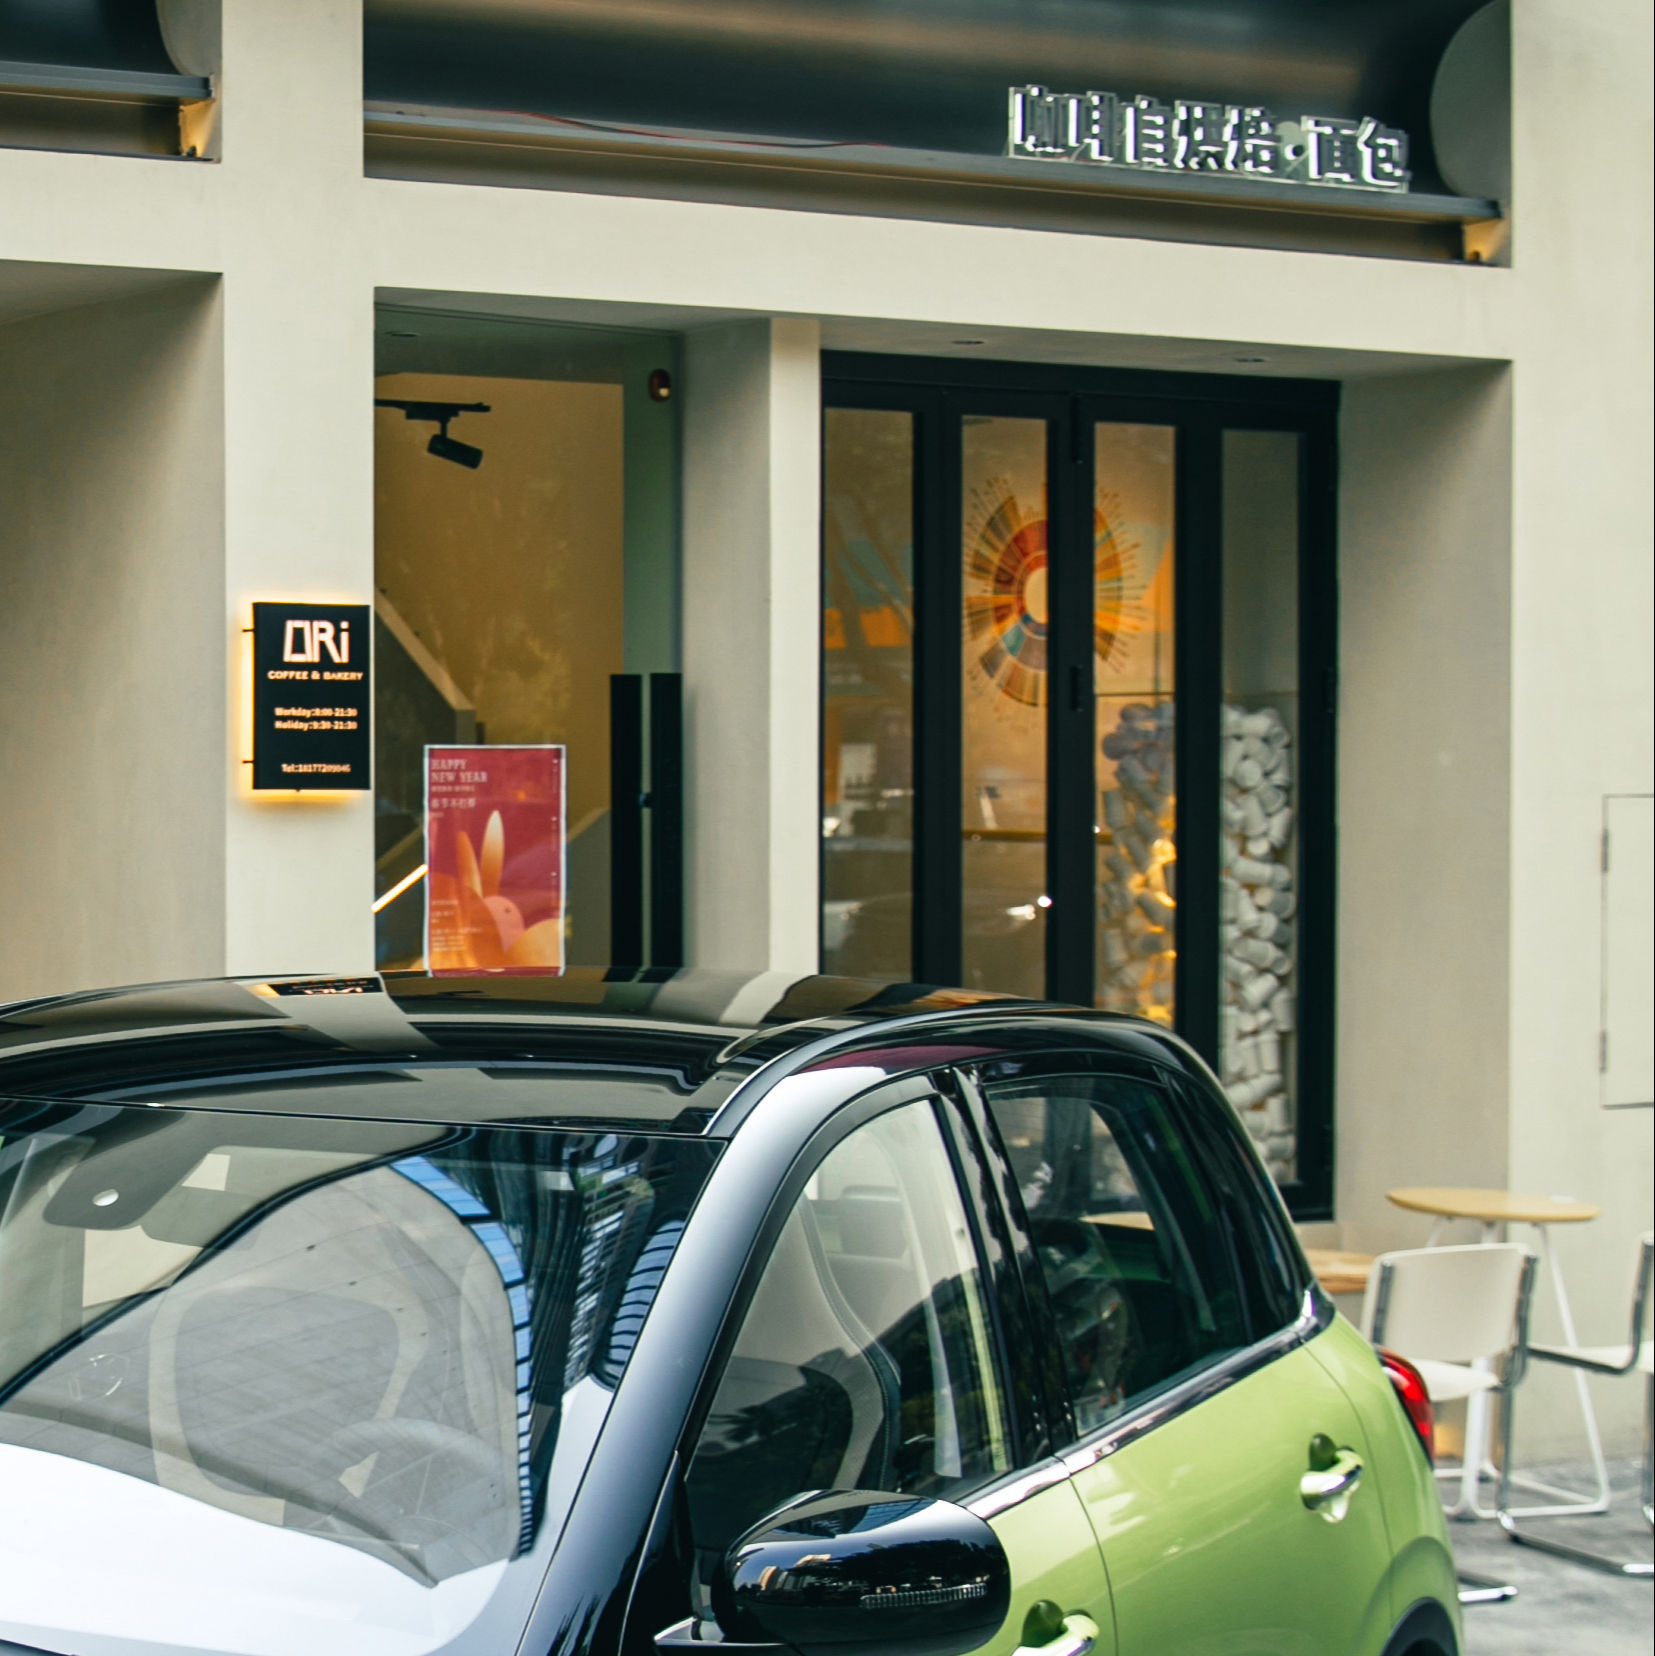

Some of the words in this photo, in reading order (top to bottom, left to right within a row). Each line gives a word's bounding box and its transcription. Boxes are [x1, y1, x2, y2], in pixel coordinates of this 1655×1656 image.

[282, 619, 350, 664] ORi
[267, 670, 309, 681] COFFEE
[311, 670, 321, 681] &
[323, 671, 364, 681] BAKERY
[431, 772, 456, 783] NEW
[459, 772, 488, 783] YEAR
